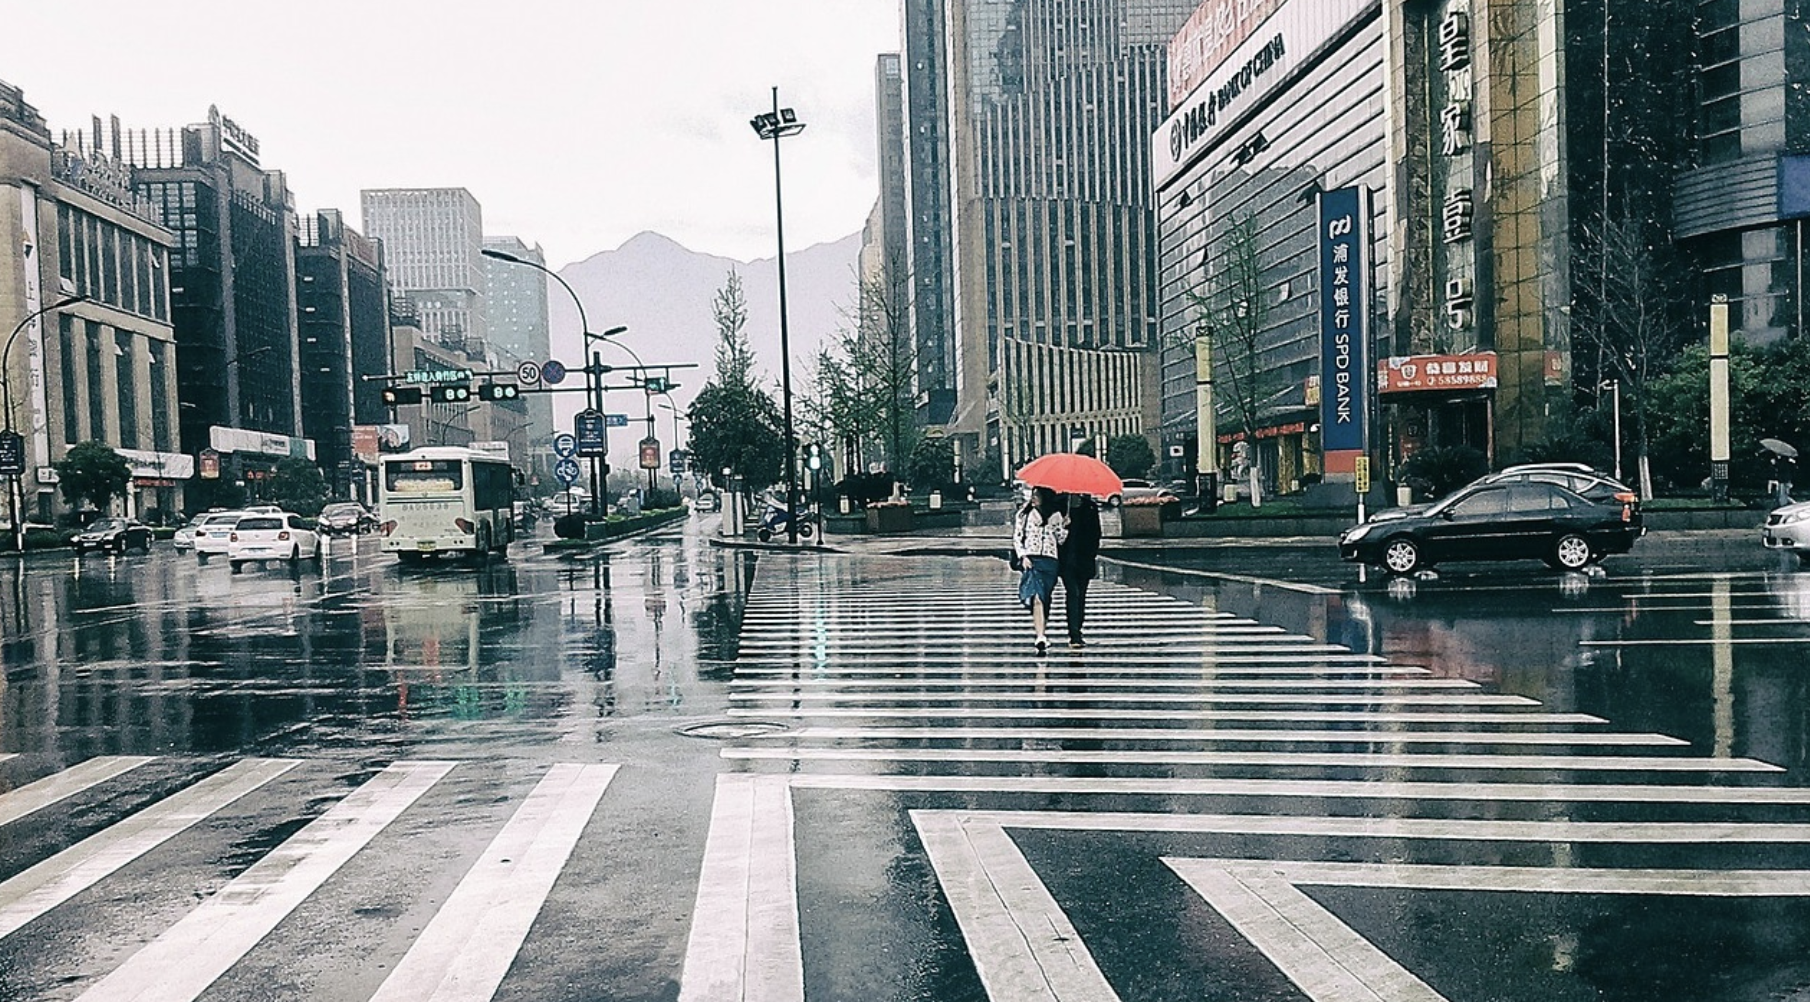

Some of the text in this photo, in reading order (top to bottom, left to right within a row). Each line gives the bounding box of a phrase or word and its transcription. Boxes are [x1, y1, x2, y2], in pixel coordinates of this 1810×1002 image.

[1218, 69, 1241, 111] BANK
[1253, 33, 1285, 78] CHINA
[1333, 244, 1349, 329] 浦发银行
[522, 367, 537, 379] 50
[1335, 333, 1350, 424] SPD BANK
